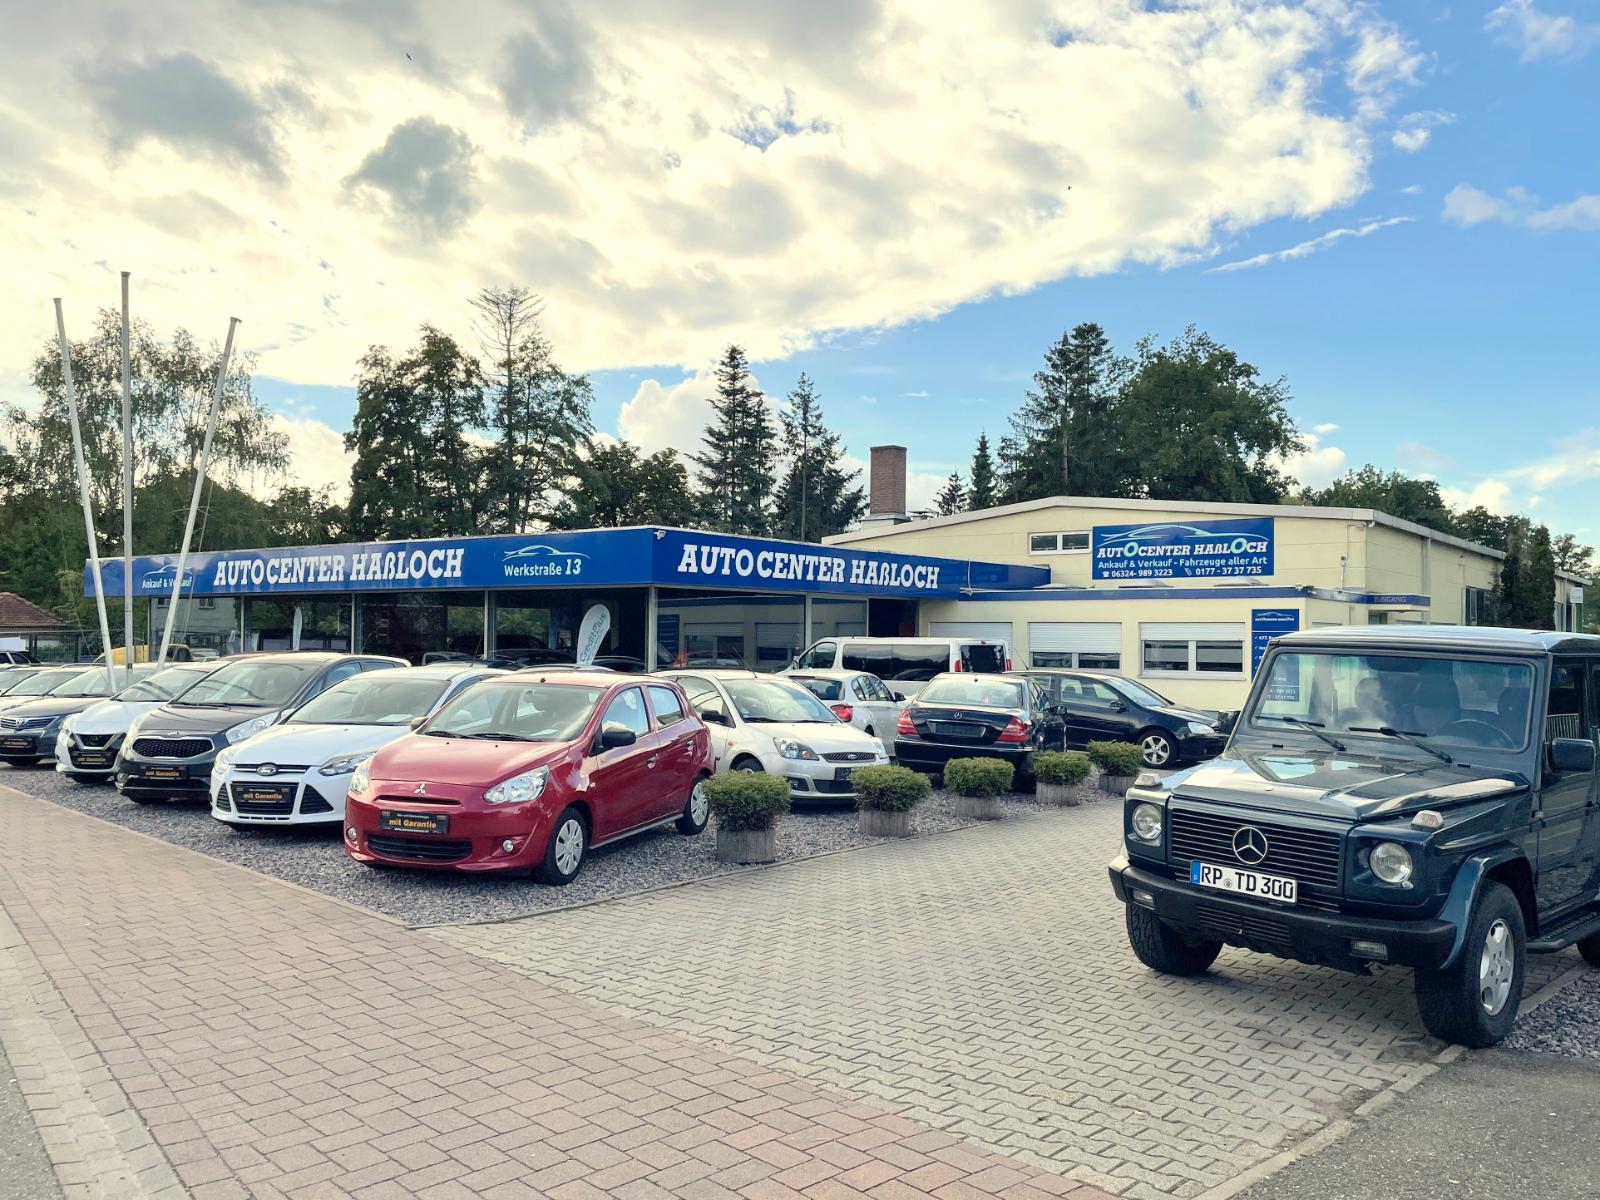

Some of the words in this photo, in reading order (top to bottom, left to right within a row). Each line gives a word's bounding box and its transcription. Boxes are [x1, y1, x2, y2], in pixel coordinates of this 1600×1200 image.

[1097, 542, 1191, 558] AUTOCENTER
[1194, 537, 1268, 555] HAßLOCH
[213, 555, 345, 586] AUTOCENTER
[350, 548, 464, 580] HAßLOCH
[504, 562, 562, 577] Werkstraße
[565, 558, 582, 575] 13
[677, 544, 846, 583] AUTOCENTER
[850, 559, 940, 589] HAßLOCH
[1098, 560, 1128, 569] Ankauf
[1129, 560, 1136, 568] &
[1137, 559, 1173, 567] Verkauf
[1179, 557, 1226, 567] Fahrzeuge
[1228, 556, 1249, 565] aller
[1251, 556, 1268, 565] Art
[1138, 569, 1152, 577] 989
[1154, 568, 1173, 577] 3223
[1195, 567, 1215, 576] 0177
[1222, 567, 1233, 575] 37
[1234, 566, 1244, 575] 37
[1246, 566, 1262, 574] 735
[142, 578, 163, 589] Ankauf
[403, 819, 437, 829] Garantie
[1201, 866, 1223, 885] RP
[1234, 871, 1257, 892] TD
[1260, 876, 1294, 900] 300
